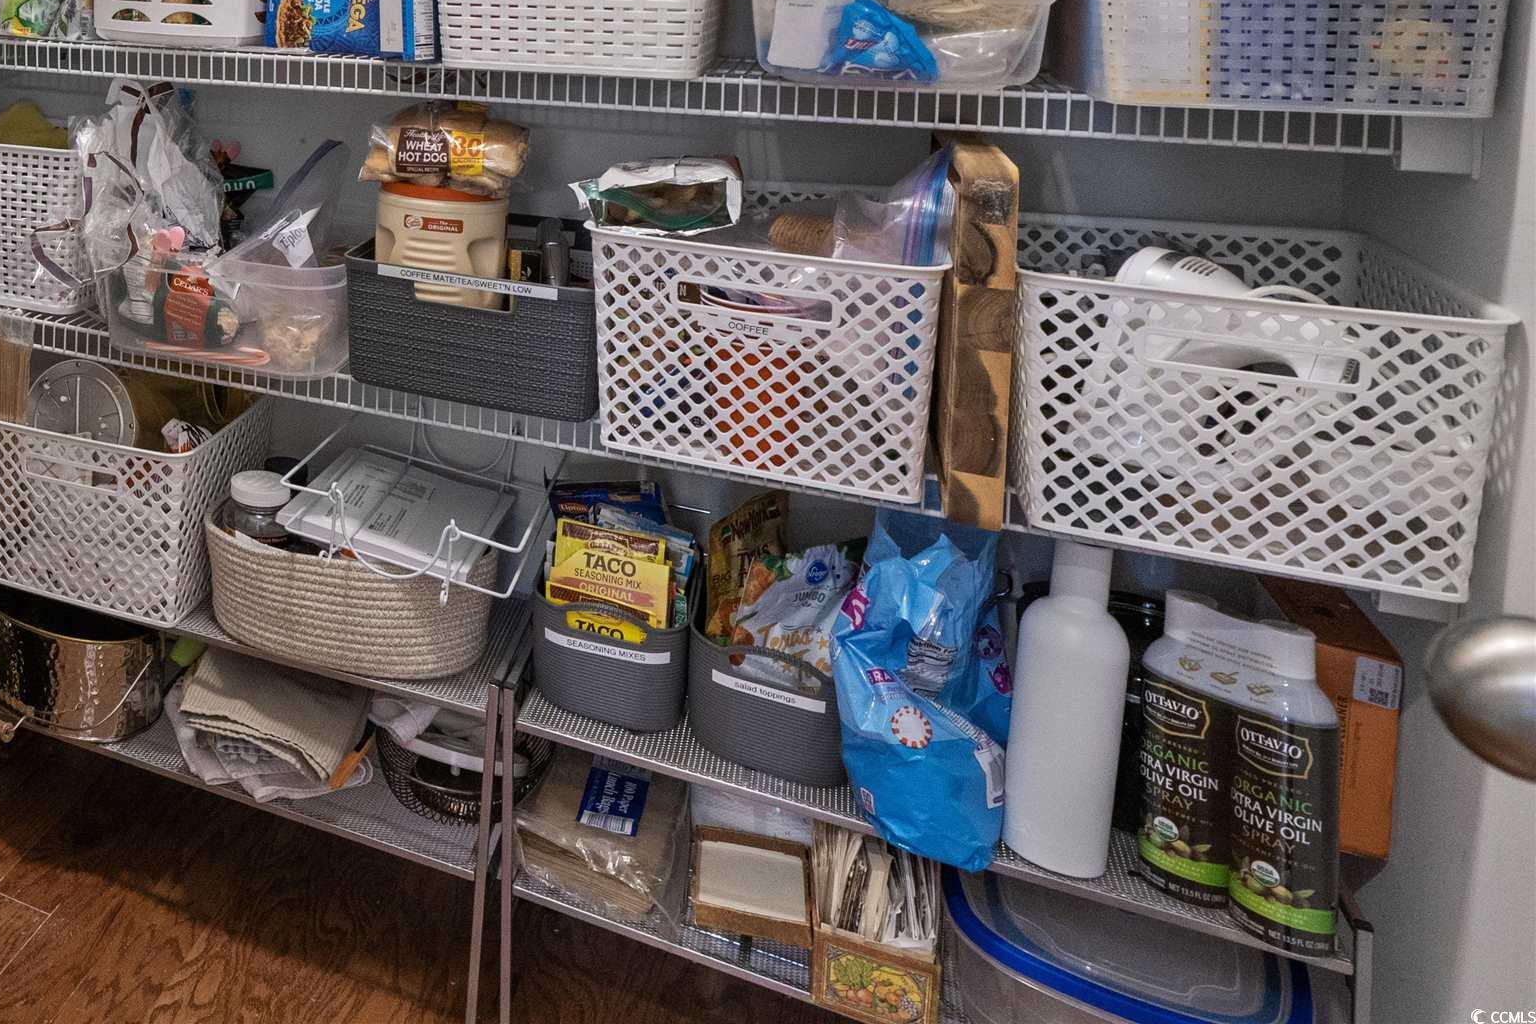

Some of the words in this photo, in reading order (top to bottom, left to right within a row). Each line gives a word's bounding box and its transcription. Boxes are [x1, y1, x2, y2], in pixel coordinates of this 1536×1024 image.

[398, 151, 422, 162] HOT
[423, 152, 448, 163] DOG
[405, 140, 444, 152] WHEAT
[427, 224, 460, 233] ORIGINAL
[399, 268, 432, 280] COFFEE
[512, 285, 532, 295] LOW
[727, 320, 769, 336] COFFEE
[583, 551, 637, 578] TACO
[573, 567, 625, 587] SEASONING
[625, 579, 642, 591] MIX
[578, 582, 636, 604] ORIGINAL
[791, 591, 826, 604] JUMBO
[566, 638, 617, 657] SEASONING
[617, 649, 647, 662] MIXES
[734, 680, 758, 695] salad
[758, 687, 797, 705] toppings
[1144, 689, 1201, 722] OTTAVIO
[1239, 726, 1305, 761] OTTAVIO
[1165, 764, 1220, 792] VIRGIN
[1177, 782, 1208, 803] OIL
[1233, 774, 1313, 816] ORGANIC
[1234, 804, 1276, 835] OLIVE
[1279, 825, 1311, 846] OIL
[1265, 805, 1323, 833] VIRGIN
